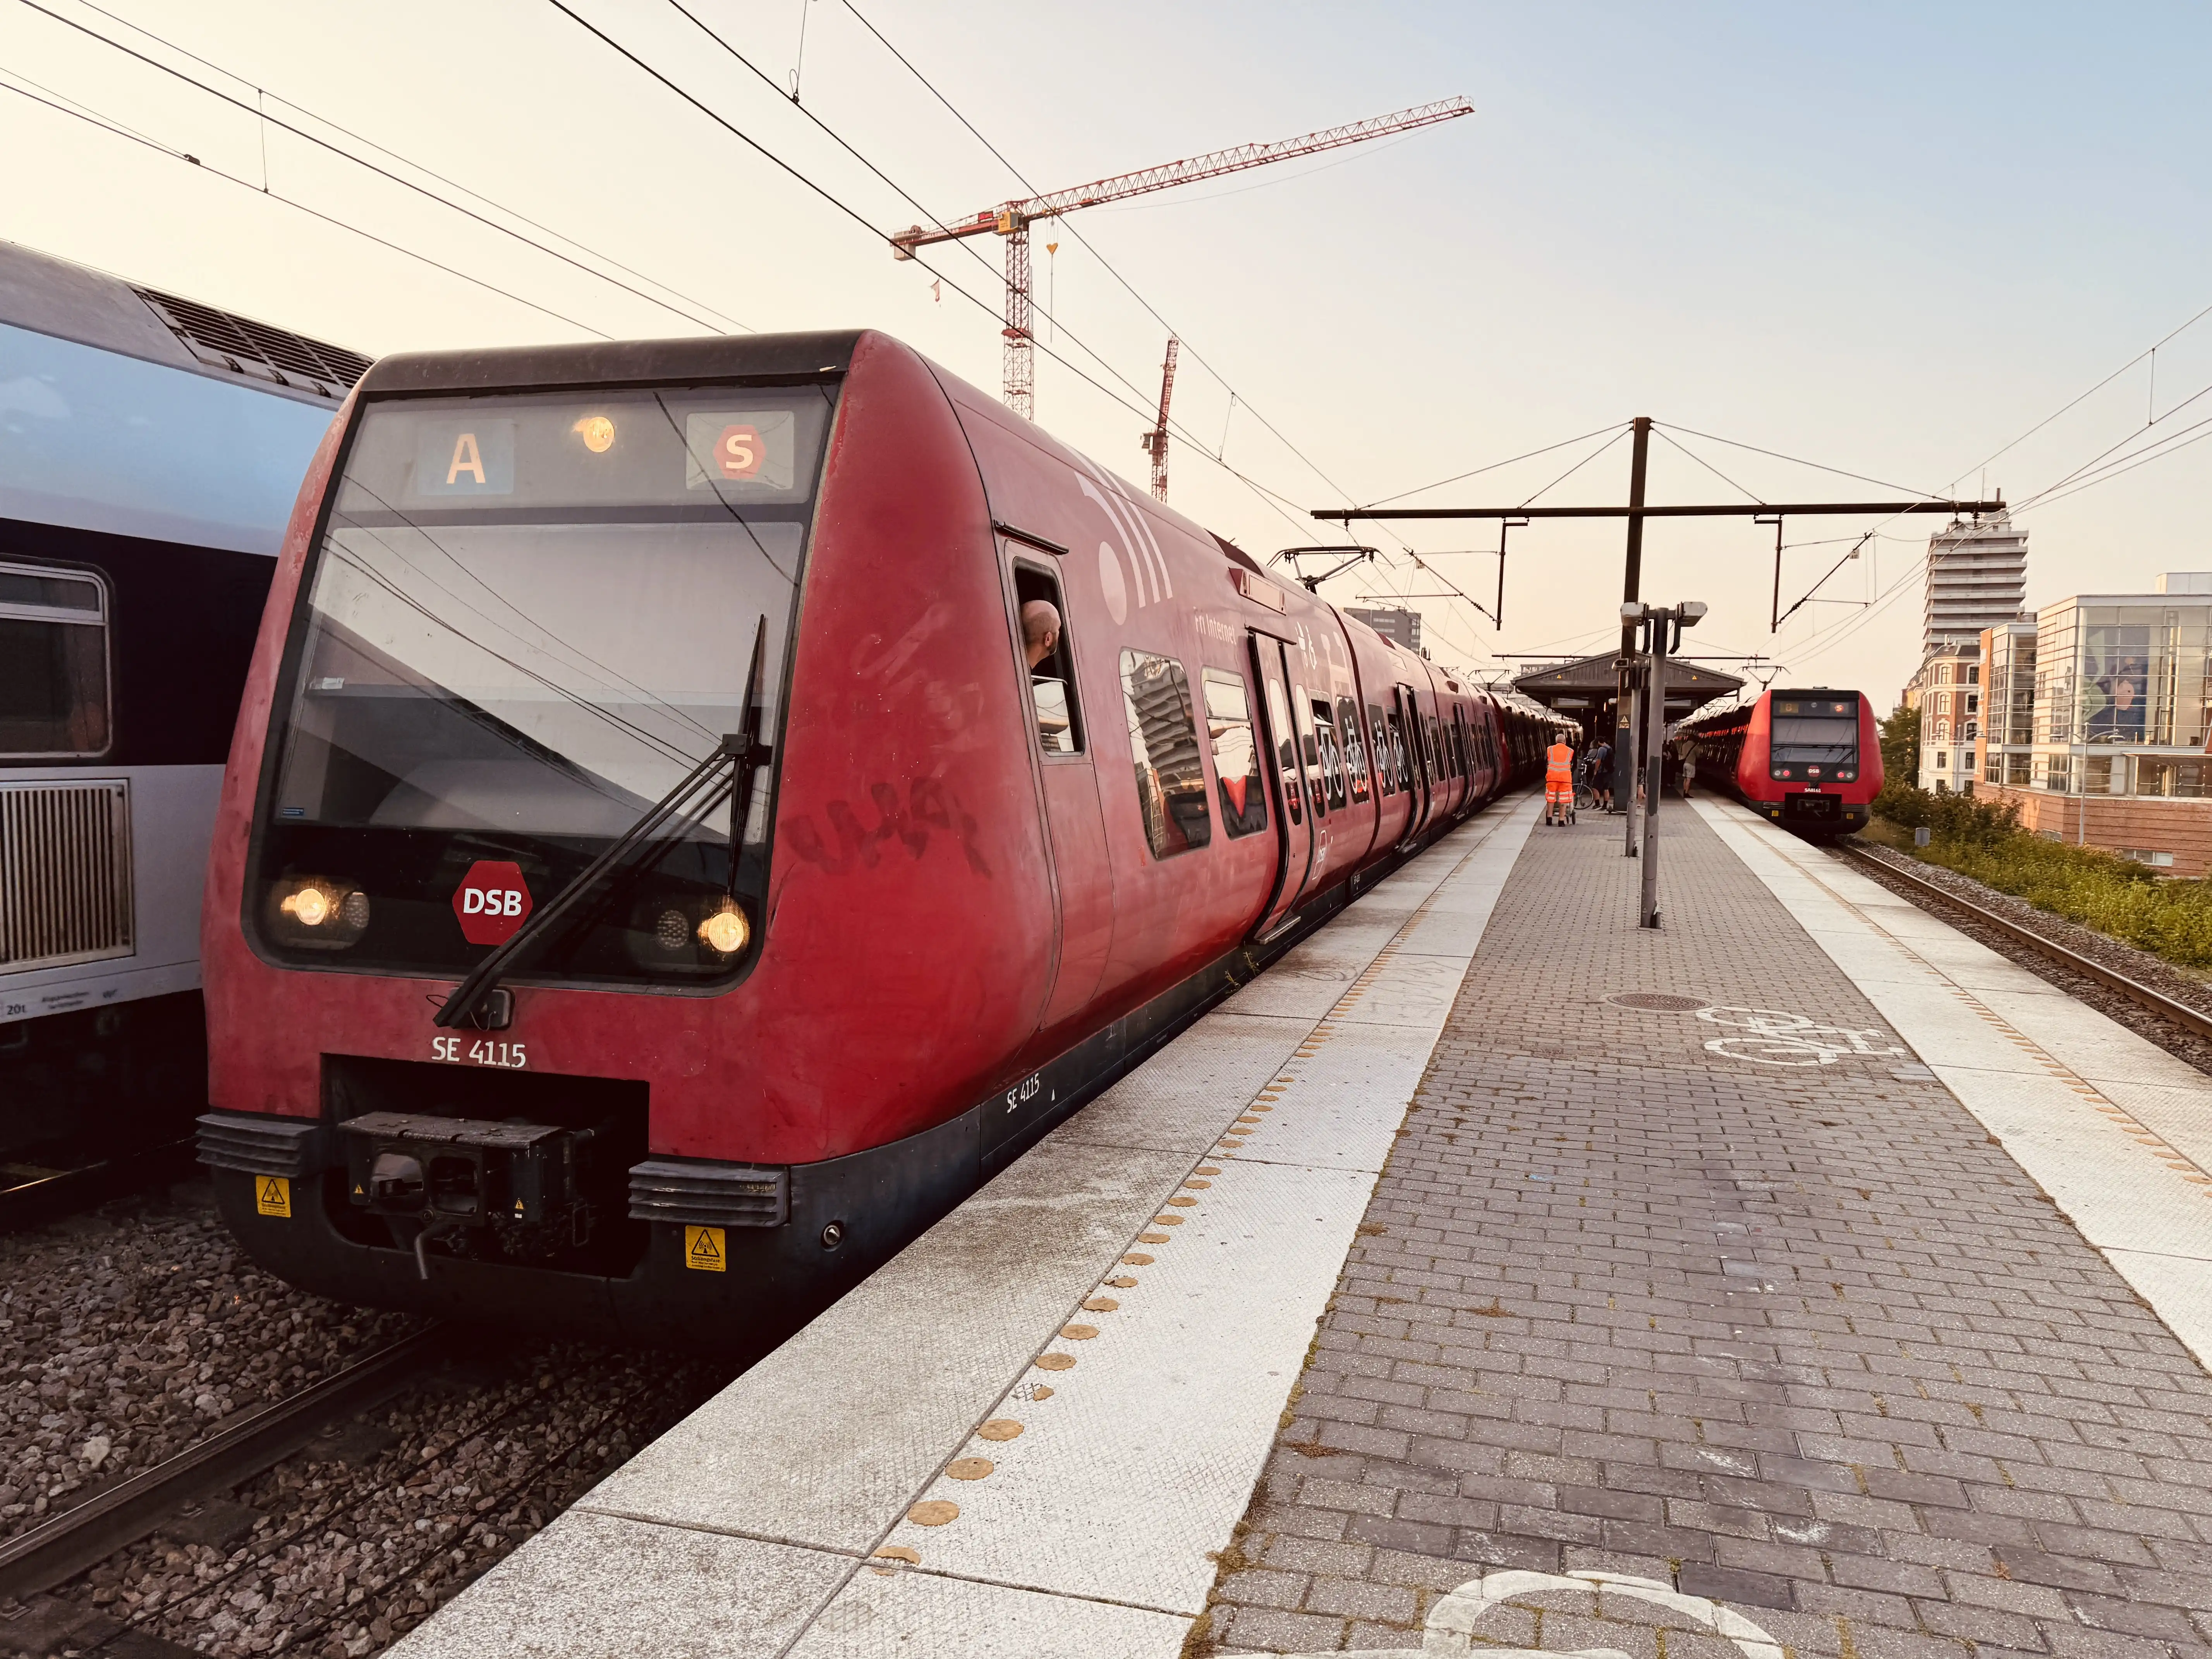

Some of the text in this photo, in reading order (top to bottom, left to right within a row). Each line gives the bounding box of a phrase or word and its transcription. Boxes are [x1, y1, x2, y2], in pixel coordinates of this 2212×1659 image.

[447, 433, 485, 484] A
[726, 434, 753, 469] S
[1206, 613, 1237, 645] Internet
[464, 888, 522, 916] DSB
[431, 1037, 526, 1068] SE 4115
[1007, 1072, 1039, 1114] SE 4115
